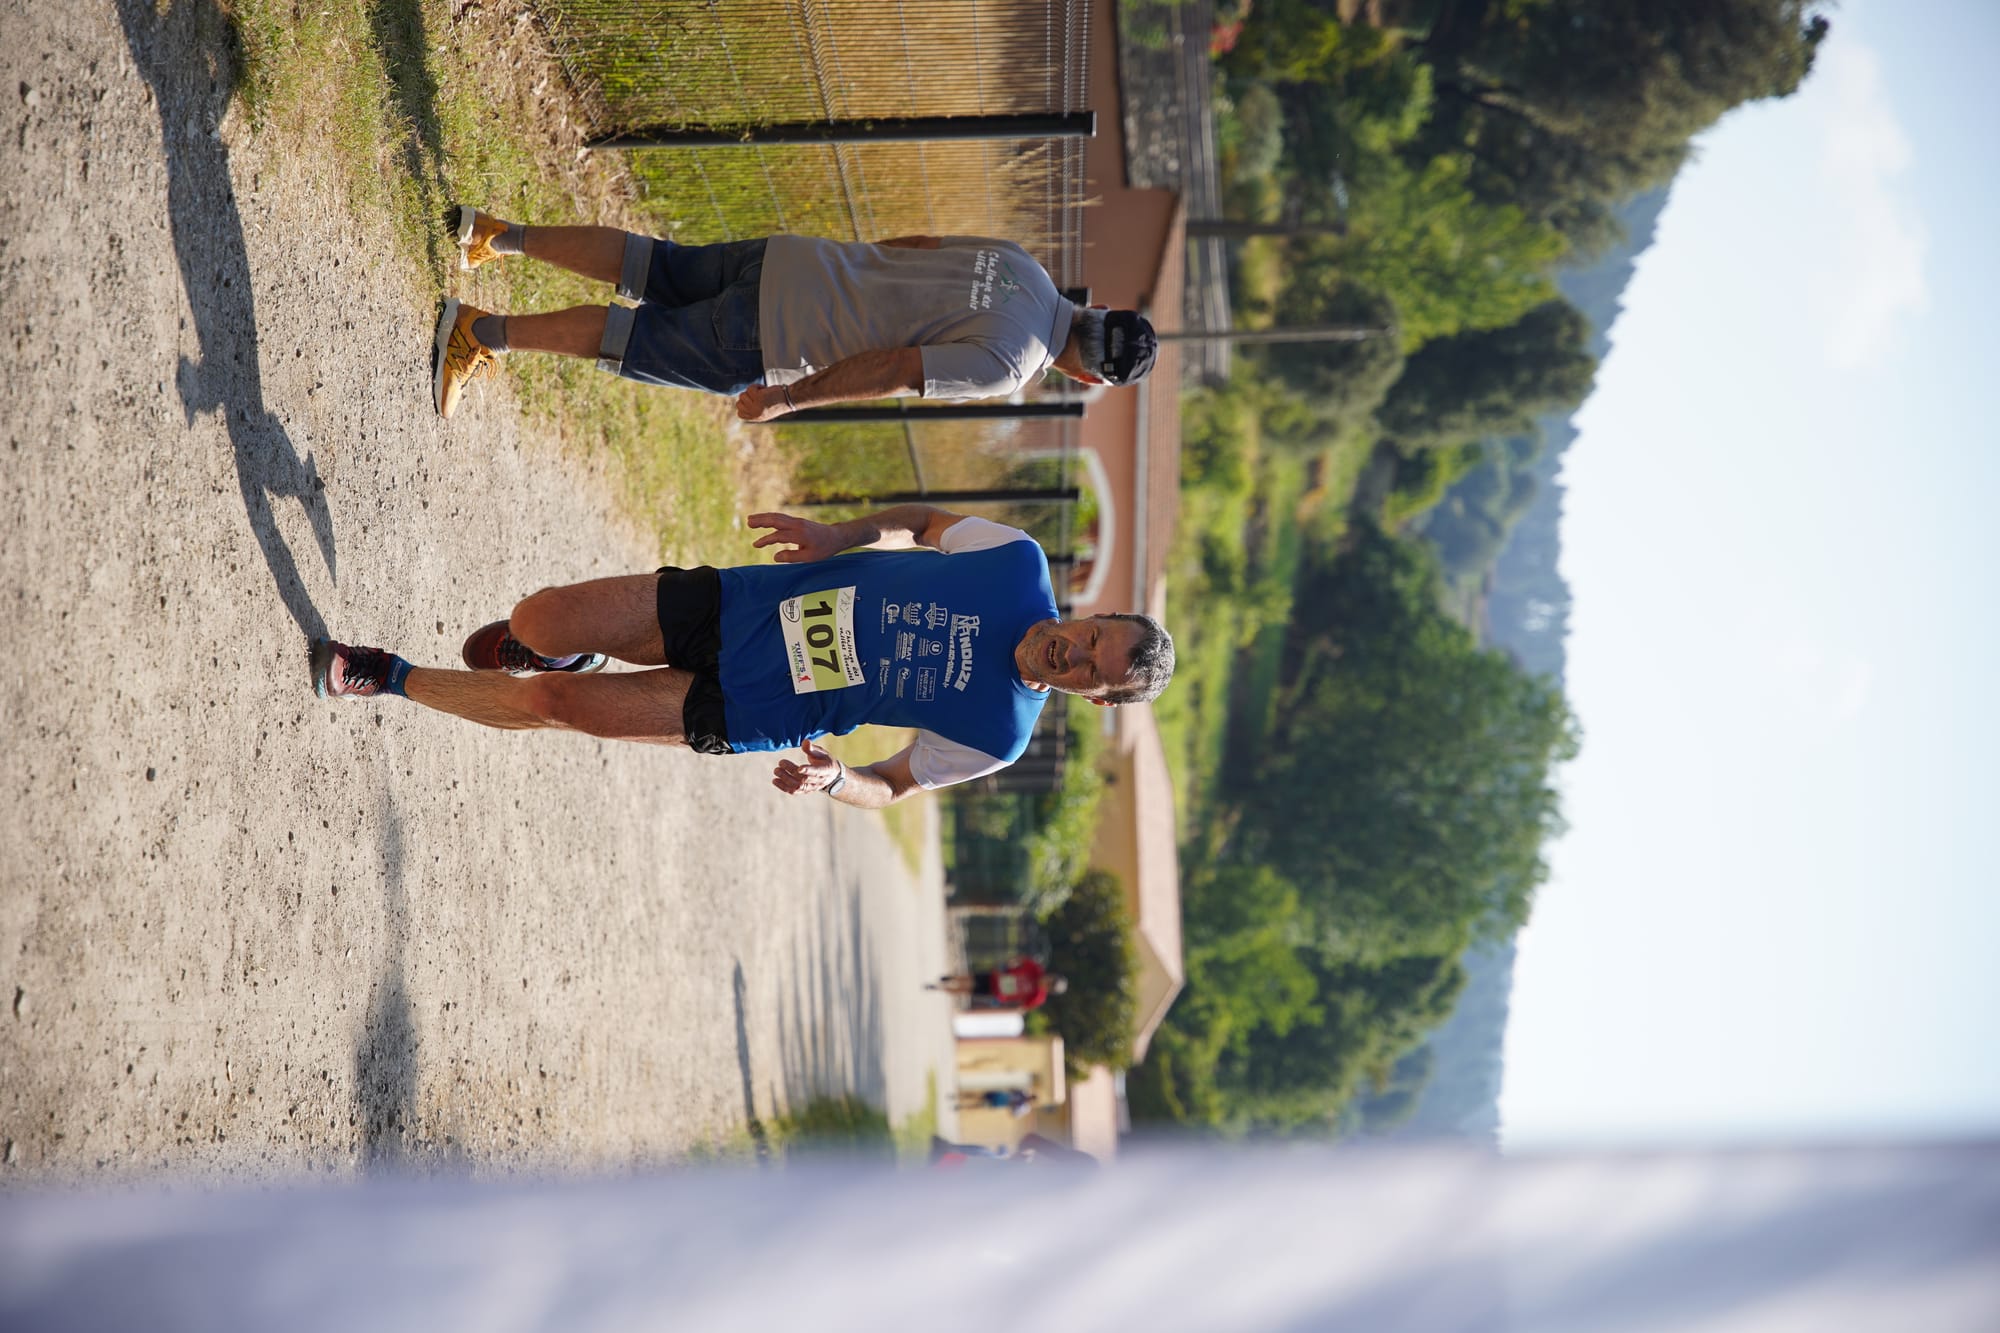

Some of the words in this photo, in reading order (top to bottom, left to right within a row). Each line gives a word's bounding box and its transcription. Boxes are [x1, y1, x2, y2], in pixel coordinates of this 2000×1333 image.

[984, 252, 1000, 292] Challenge
[982, 295, 992, 308] des
[804, 601, 840, 673] 107
[846, 630, 854, 663] Challenge
[795, 642, 806, 673] TUFF'S
